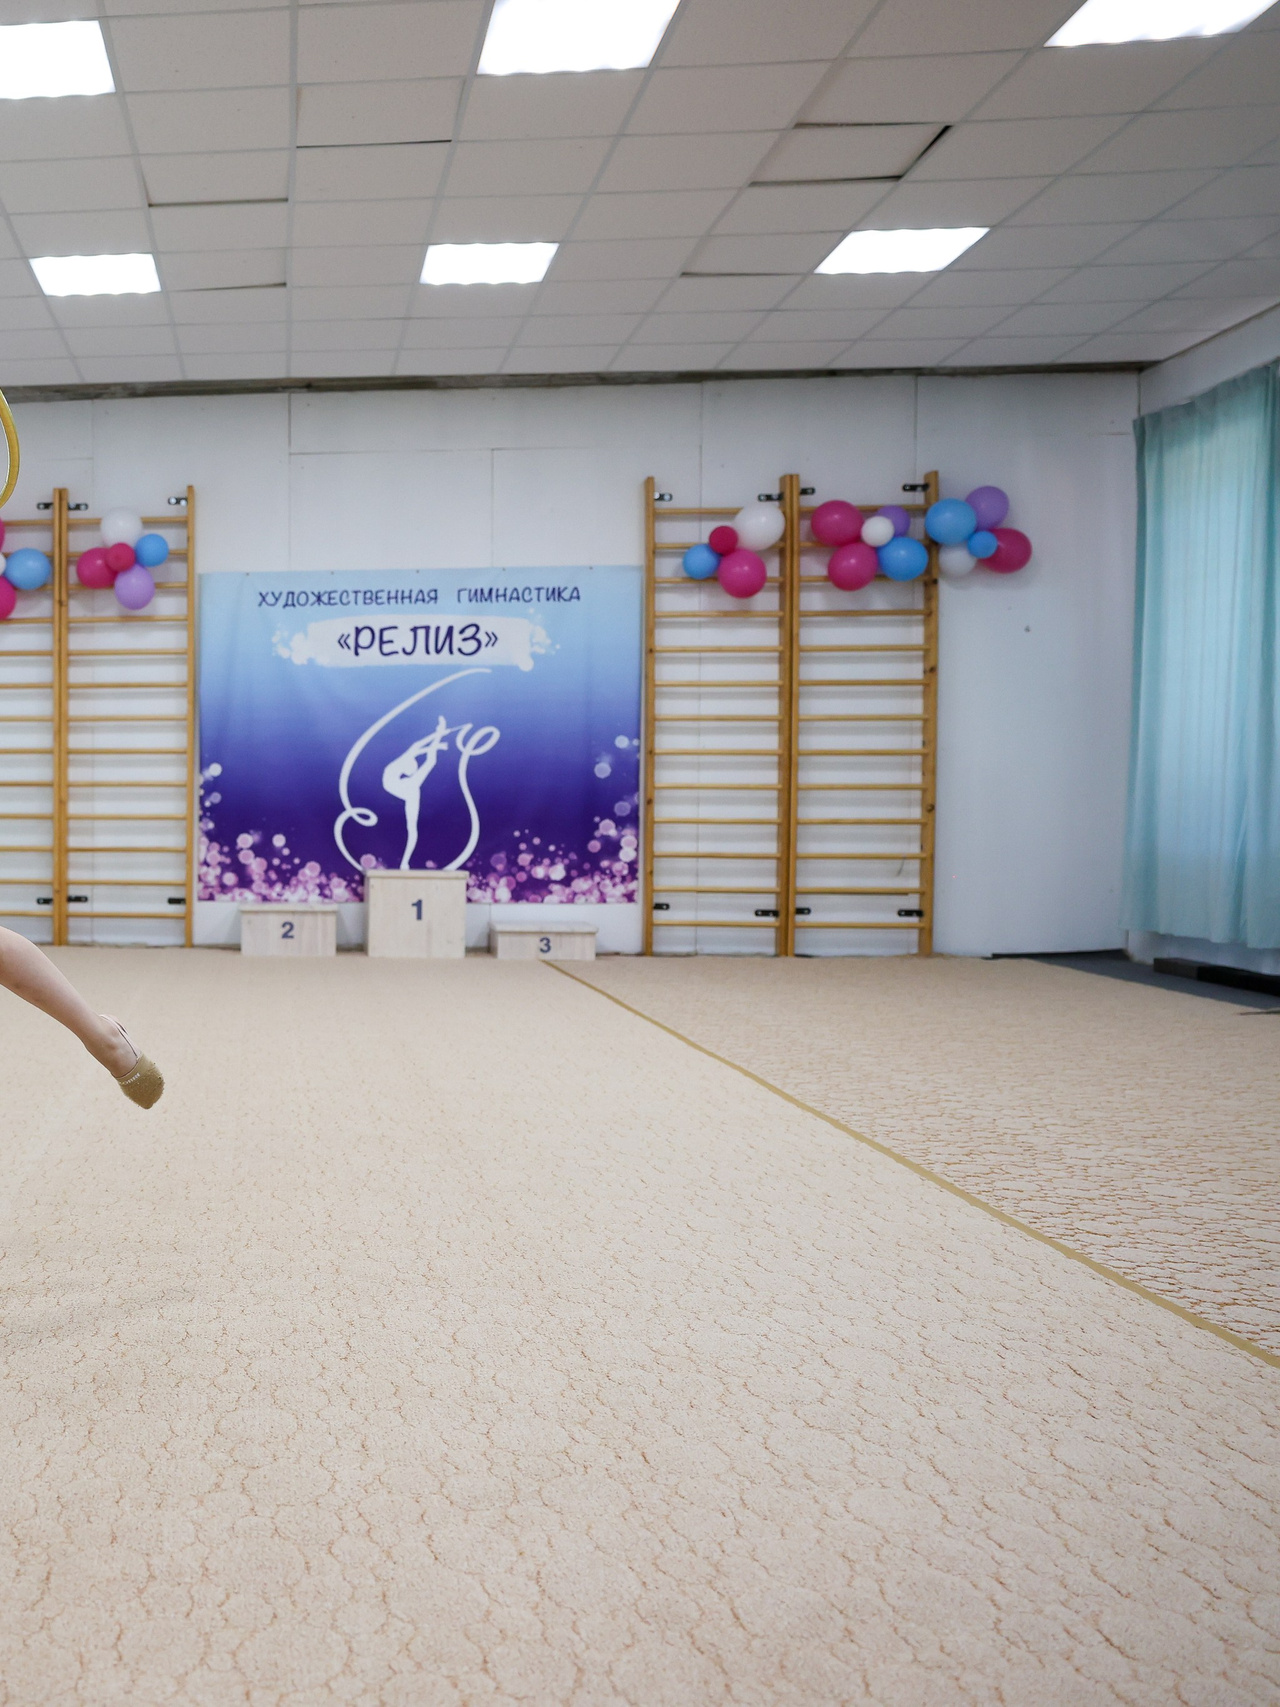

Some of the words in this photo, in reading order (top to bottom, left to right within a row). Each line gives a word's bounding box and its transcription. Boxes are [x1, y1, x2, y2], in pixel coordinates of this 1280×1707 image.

[258, 589, 438, 608] ХУДОЖЕСТВЕННАЯ
[457, 586, 581, 603] ГИМНАСТИКА
[337, 623, 498, 656] «РЕЛИЗ»
[412, 899, 423, 920] 1
[281, 922, 294, 939] 2
[540, 937, 552, 953] 3
